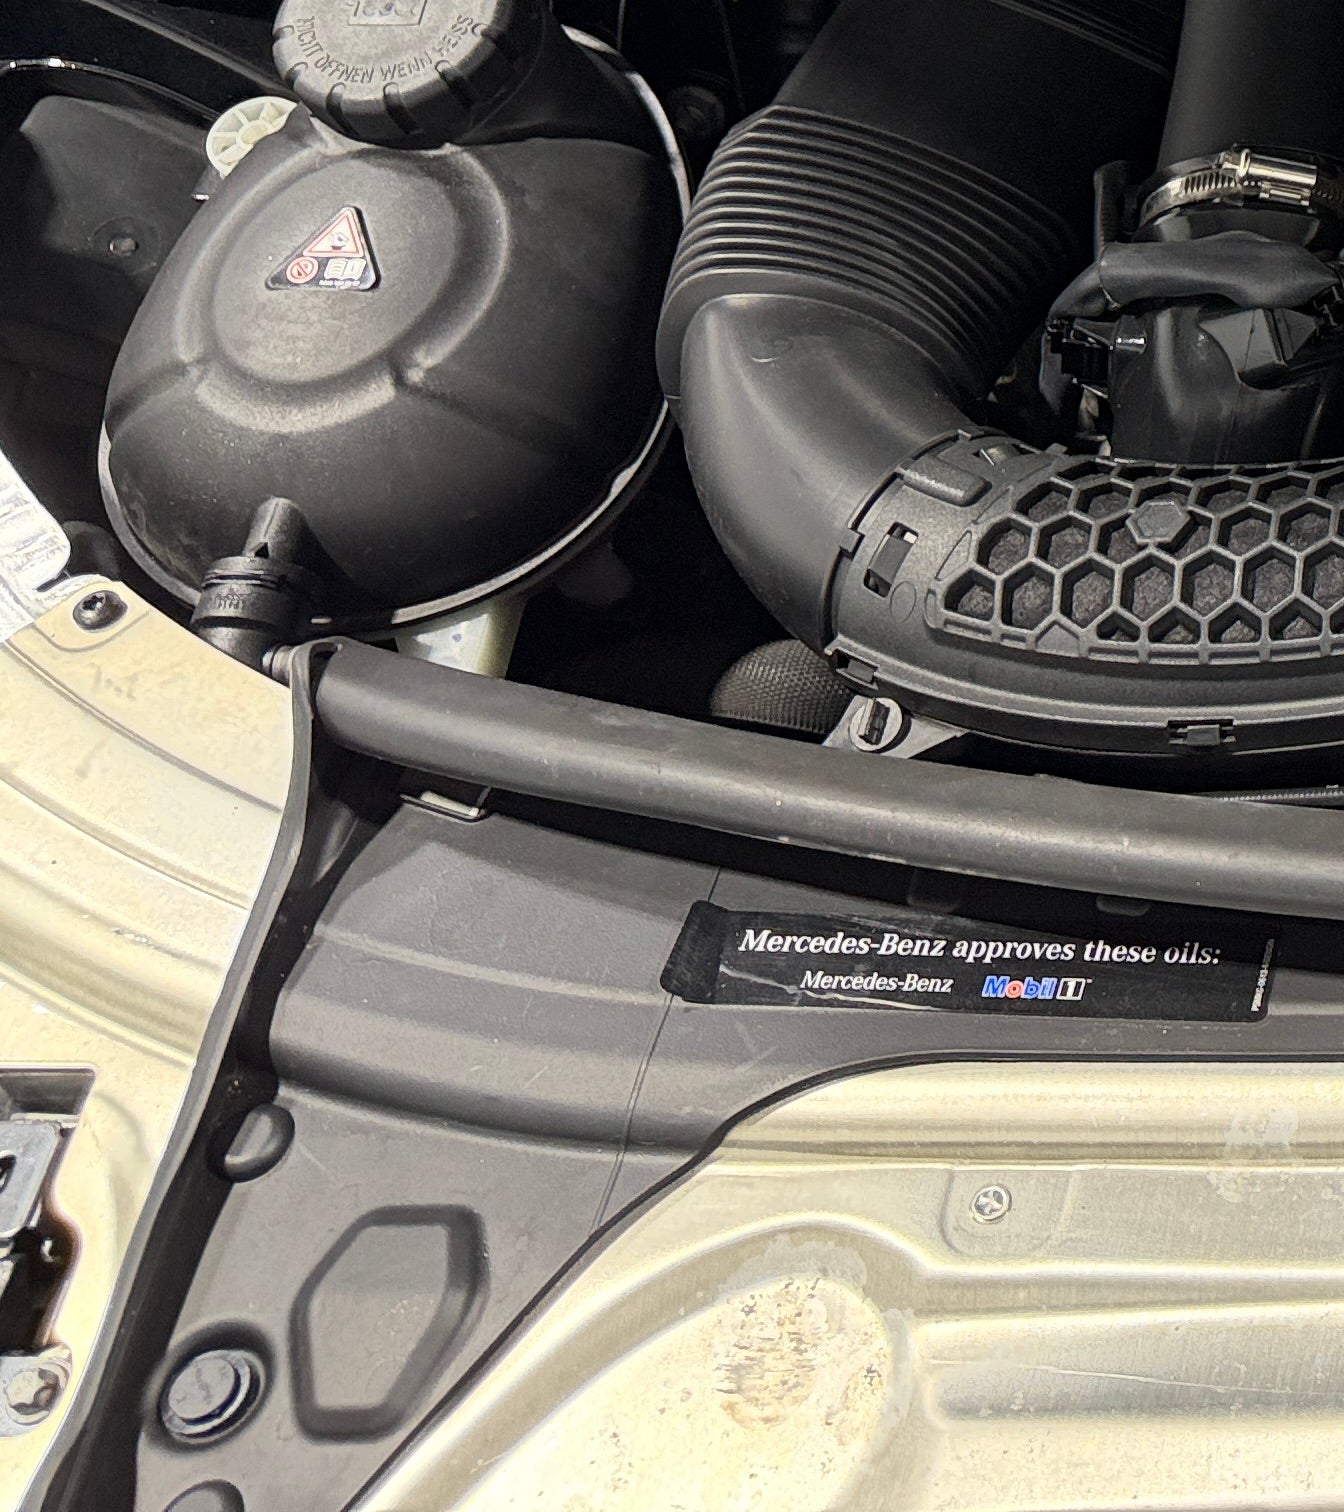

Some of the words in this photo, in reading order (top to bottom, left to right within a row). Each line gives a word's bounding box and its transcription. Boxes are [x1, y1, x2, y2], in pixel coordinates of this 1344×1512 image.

[738, 929, 947, 957] Mercedes-Benz
[951, 940, 1076, 964] approves
[1083, 939, 1157, 963] these
[1163, 942, 1221, 965] oils:
[800, 970, 954, 993] Mercedes-Benz
[981, 975, 1058, 1000] Mobil
